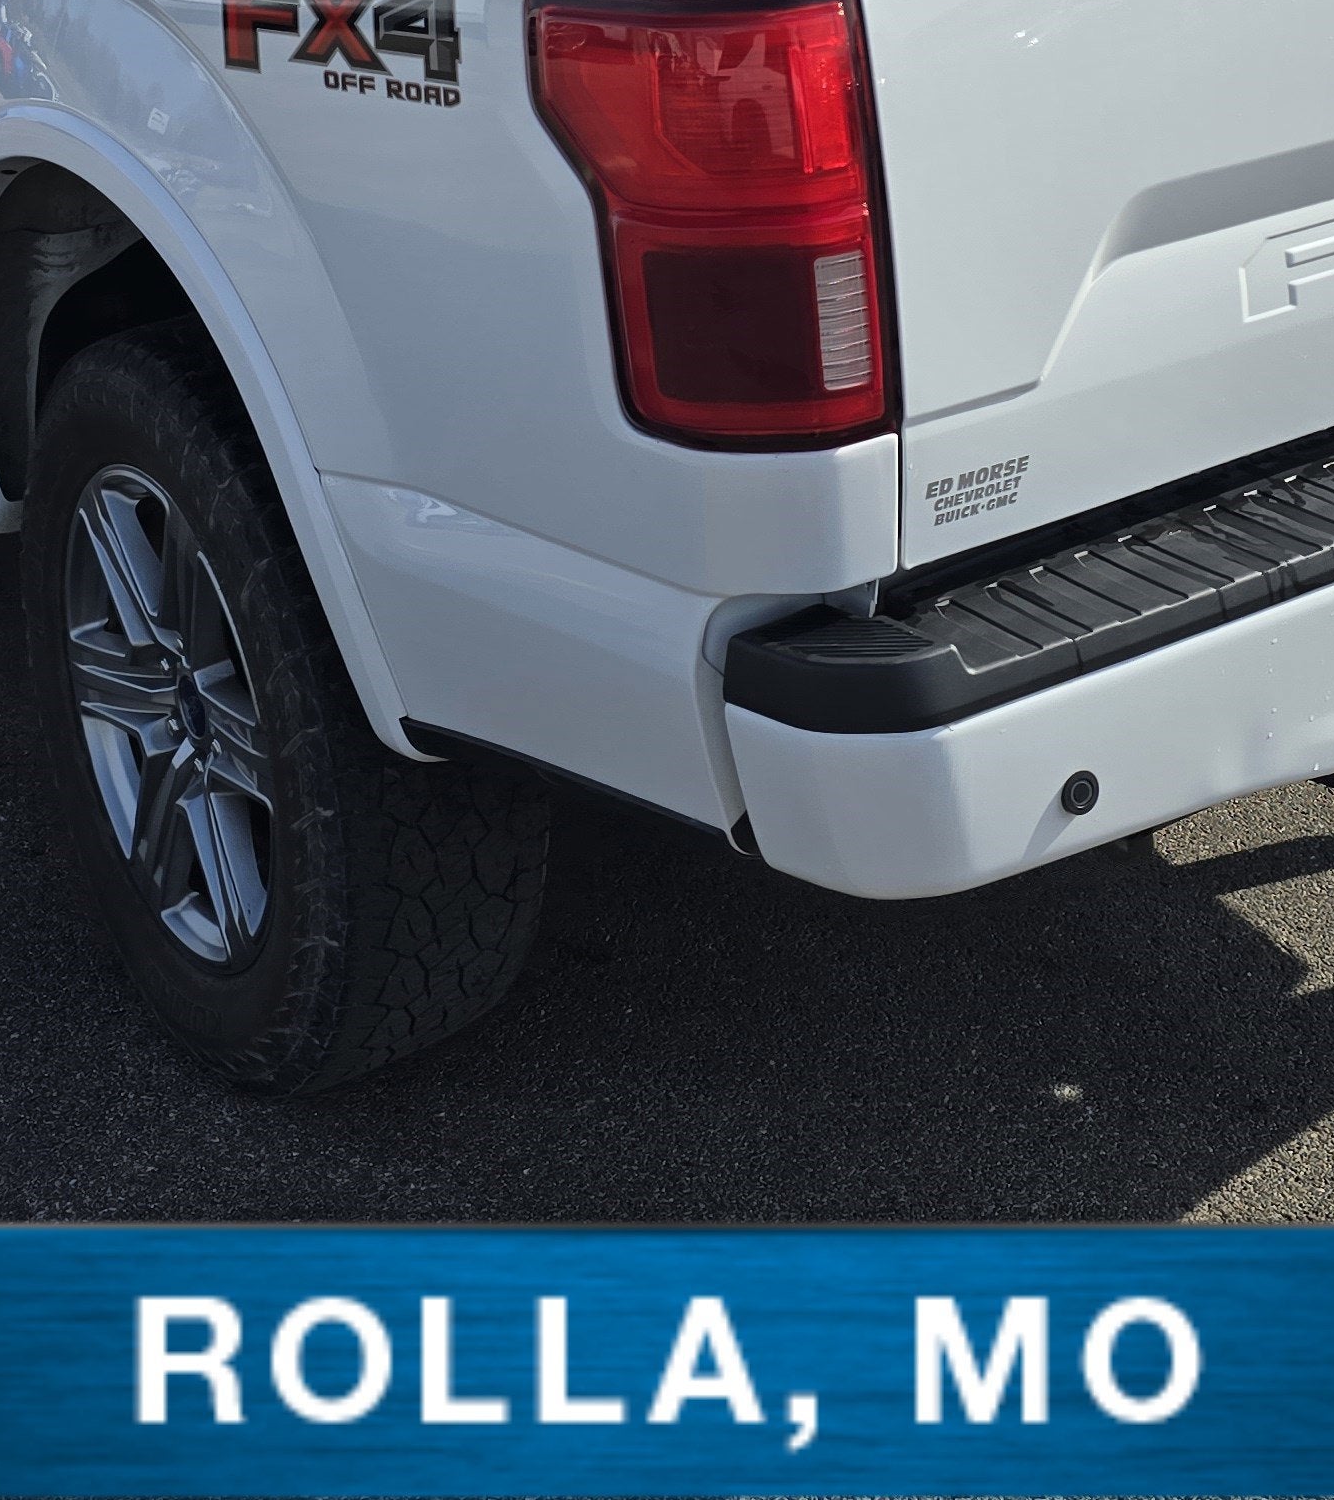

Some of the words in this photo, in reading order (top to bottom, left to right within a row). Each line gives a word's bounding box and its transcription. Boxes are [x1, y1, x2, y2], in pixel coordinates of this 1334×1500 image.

[323, 69, 377, 95] OFF
[385, 77, 462, 108] ROAD
[925, 477, 954, 500] ED
[956, 455, 1030, 491] MORSE
[933, 475, 1022, 512] CHEVROLET
